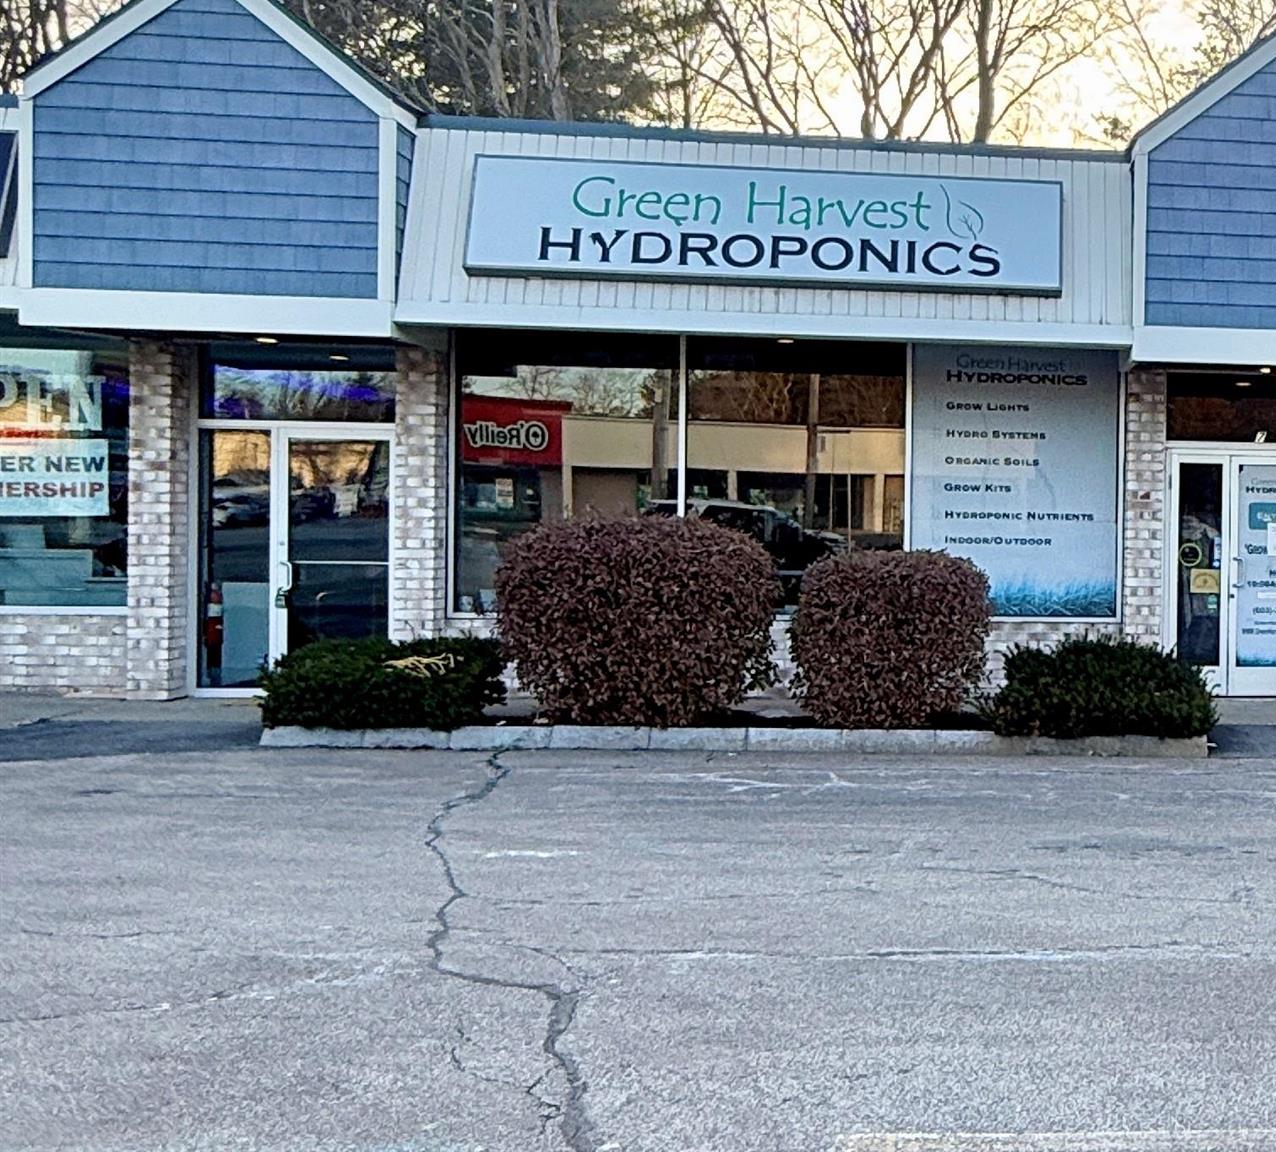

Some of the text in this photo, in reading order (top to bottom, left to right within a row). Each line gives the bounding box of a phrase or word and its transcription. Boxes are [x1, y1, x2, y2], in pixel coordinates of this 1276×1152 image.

[572, 176, 931, 231] Green Harvest
[538, 226, 1001, 277] HYDROPONICS
[956, 354, 1004, 370] Green
[946, 369, 1088, 386] HYDROPONICS
[946, 401, 1030, 412] GROW LIGHTS
[946, 429, 1047, 440] HYDRO SYSTEMS
[45, 456, 105, 473] NEW
[944, 456, 1040, 467] ORGANIC SOILS
[0, 481, 105, 498] ERSHIP
[944, 483, 1012, 493] GROW KITS
[944, 510, 1095, 522] HYDROPONIC NUTRIENTS
[944, 535, 1052, 546] INDOOR/OUTDOOR
